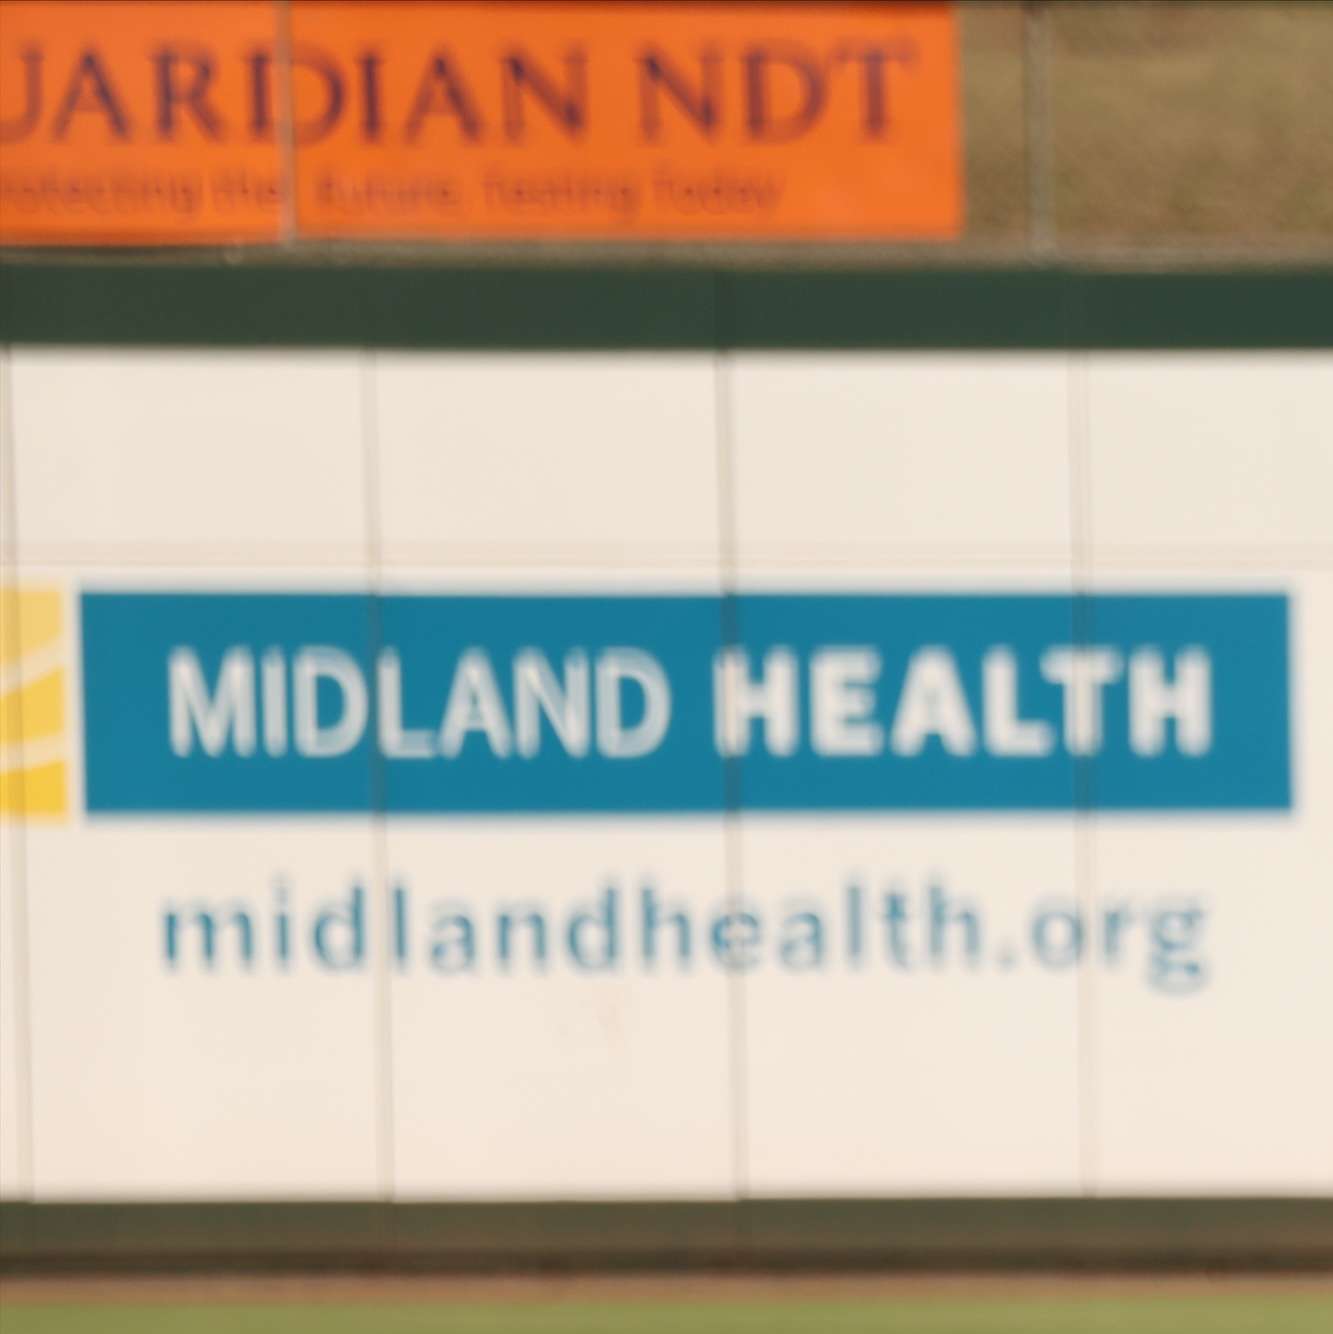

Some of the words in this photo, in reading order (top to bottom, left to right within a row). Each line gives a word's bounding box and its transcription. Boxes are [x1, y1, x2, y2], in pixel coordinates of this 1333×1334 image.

[640, 35, 918, 146] NDT
[166, 646, 671, 758] MIDLAND
[714, 645, 1213, 756] HEALTH
[162, 875, 1211, 995] midlandhealth.org
